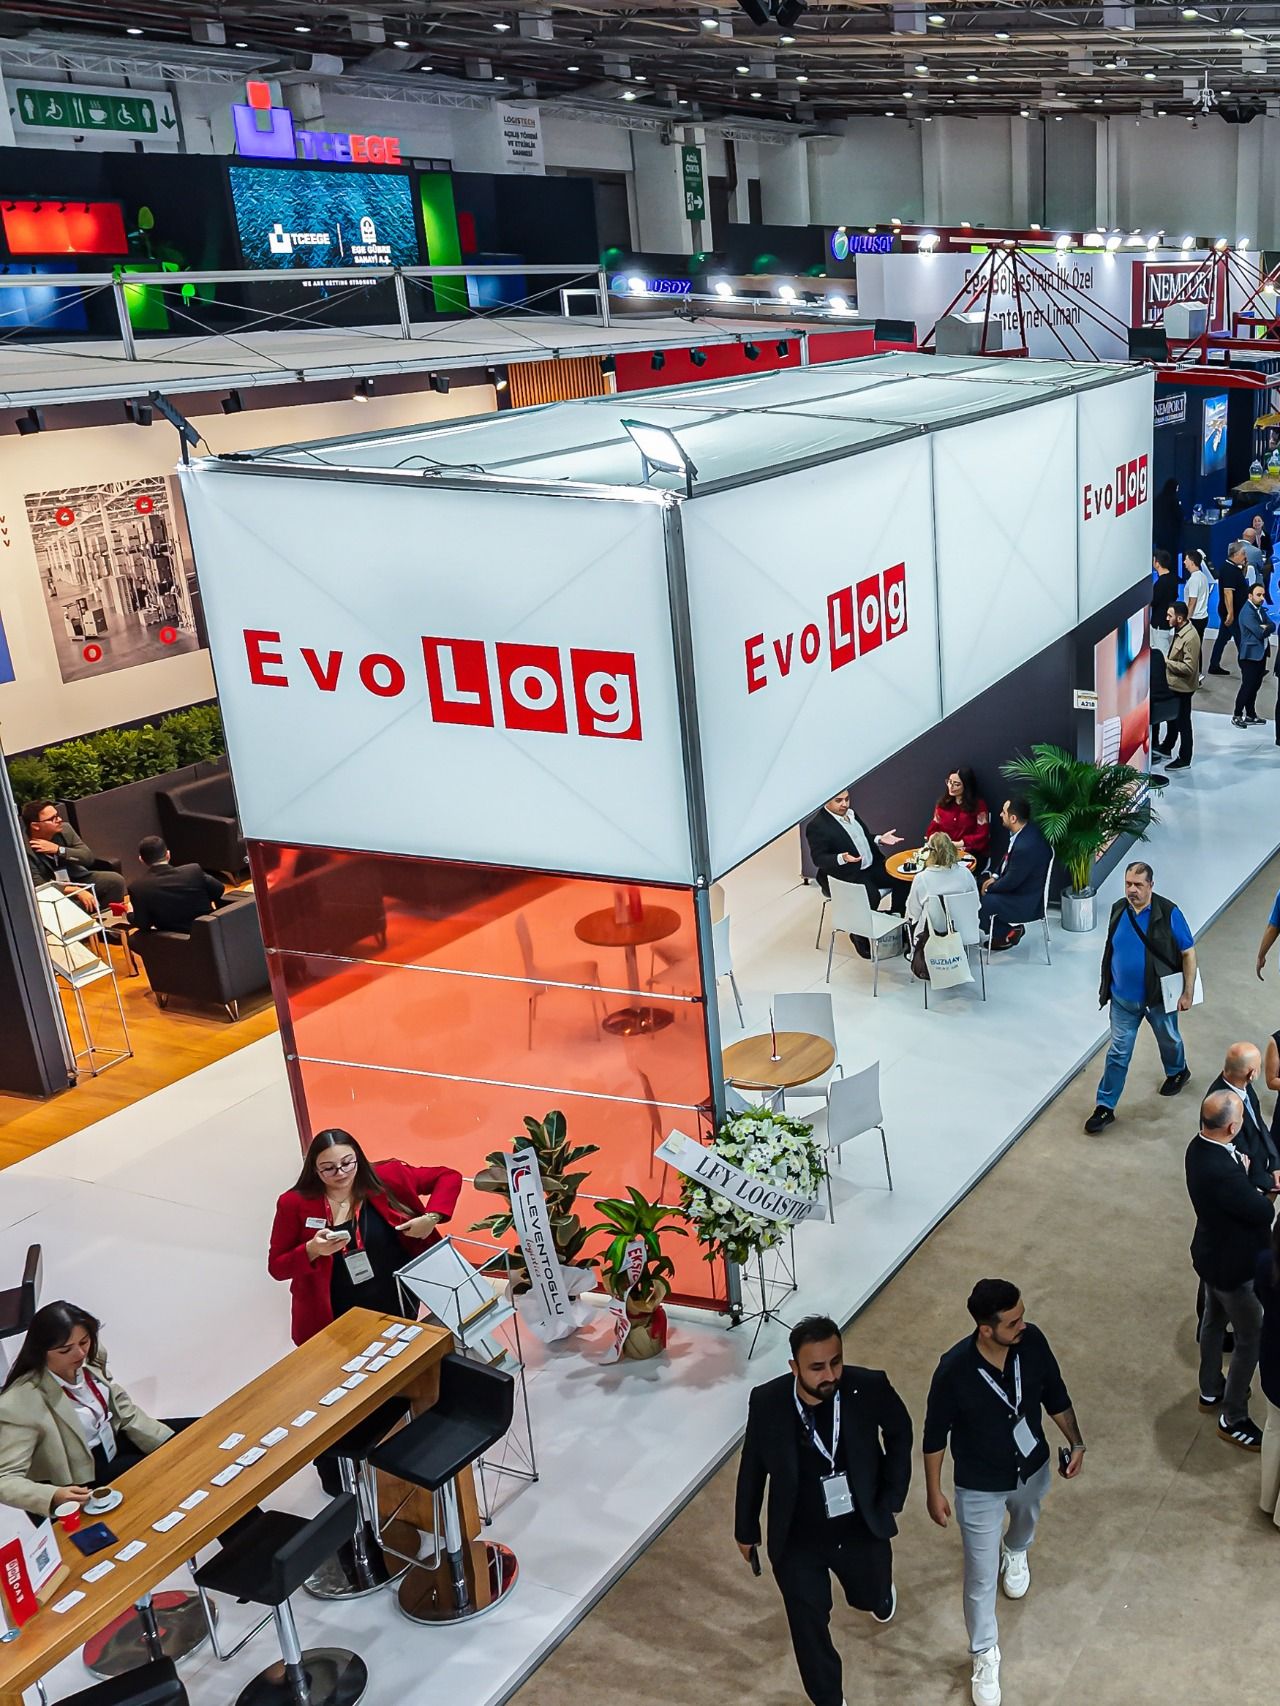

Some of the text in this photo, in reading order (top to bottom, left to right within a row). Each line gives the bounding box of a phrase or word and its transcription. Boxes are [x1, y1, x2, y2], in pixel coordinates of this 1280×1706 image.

[503, 116, 536, 126] LOGISTECH
[296, 131, 402, 165] TCEEGE
[290, 233, 331, 245] TCEEGE
[1072, 262, 1094, 289] Özel
[744, 561, 909, 695] EvoLog
[243, 629, 641, 740] EvoLog
[694, 1155, 738, 1189] LFY
[524, 1238, 542, 1279] logistics
